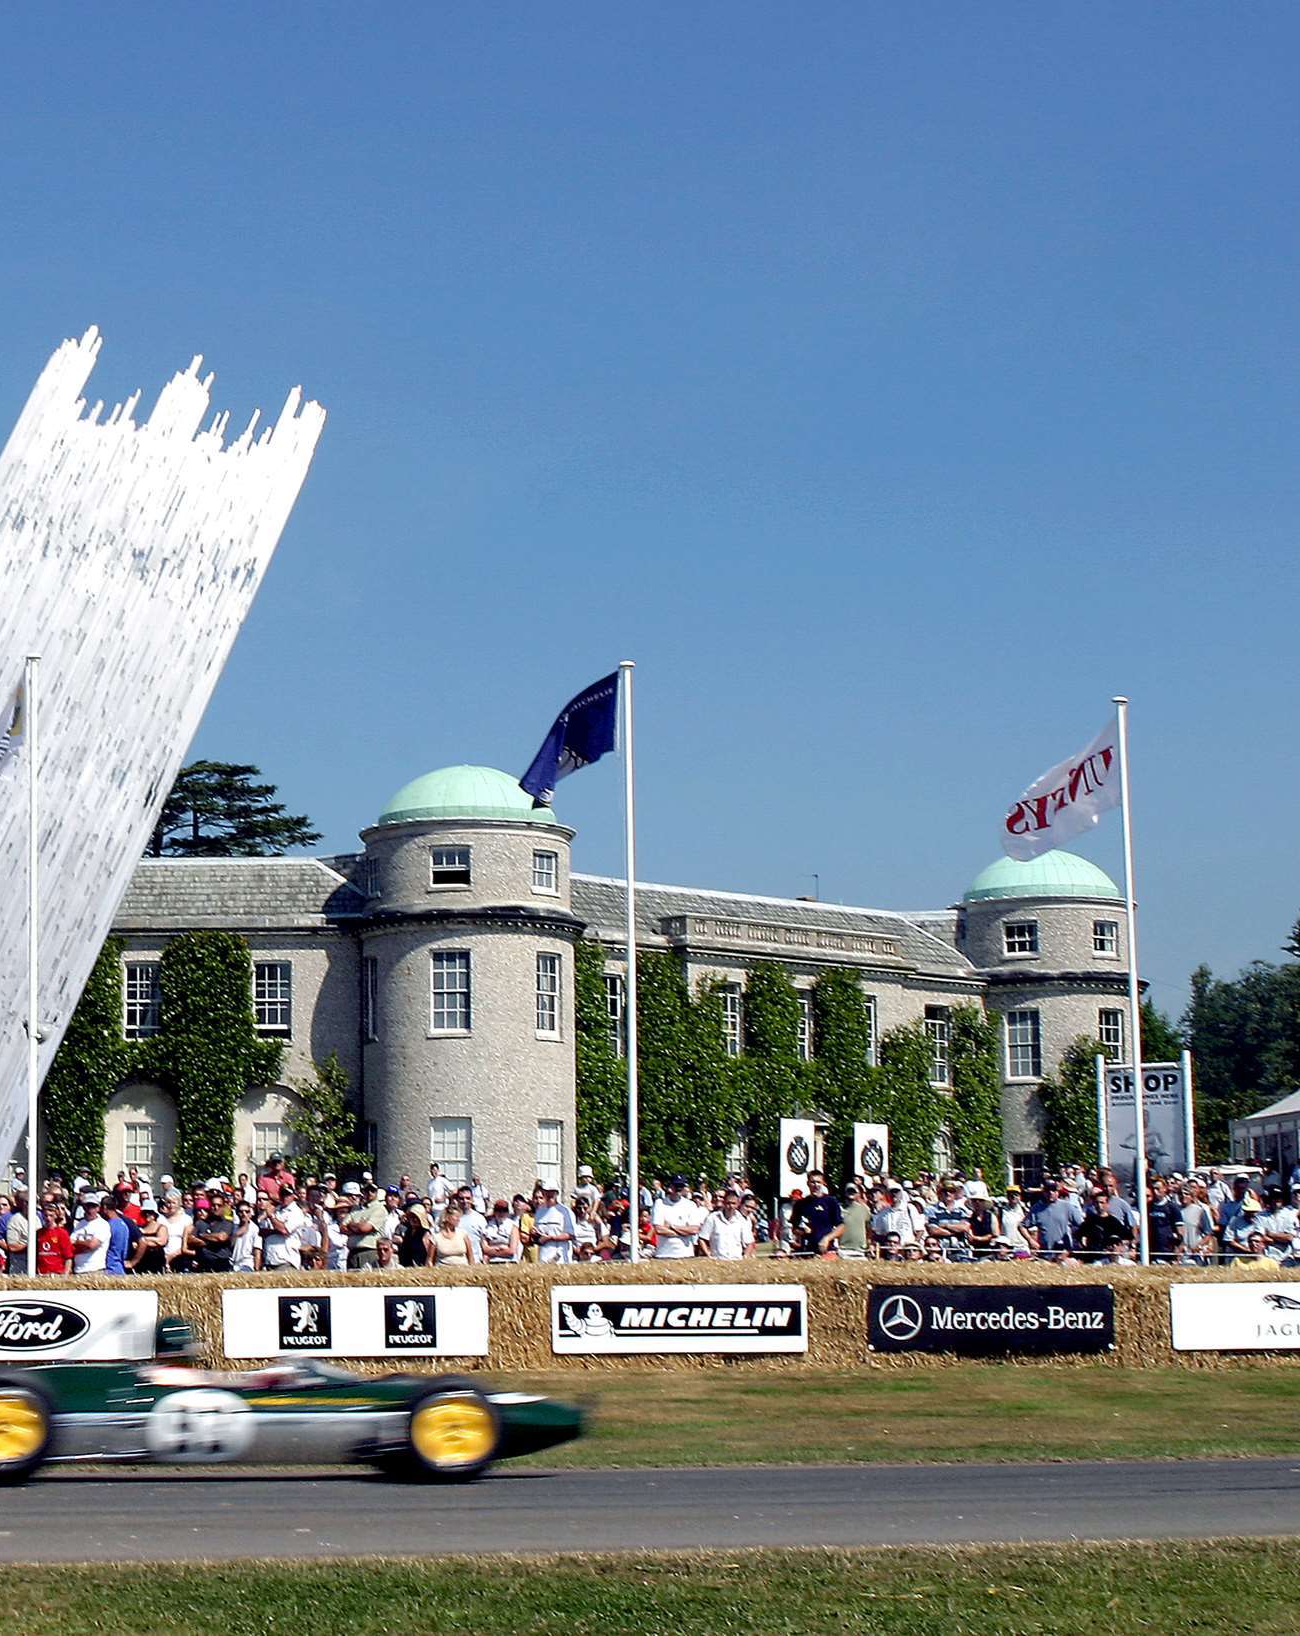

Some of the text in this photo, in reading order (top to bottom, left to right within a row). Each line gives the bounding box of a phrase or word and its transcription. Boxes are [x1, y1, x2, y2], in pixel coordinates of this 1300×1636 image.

[619, 1307, 792, 1328] MICHELIN
[930, 1306, 1105, 1330] Mercedes-Benz
[282, 1335, 328, 1346] PEUGEOT
[388, 1334, 433, 1344] PEUGEOT
